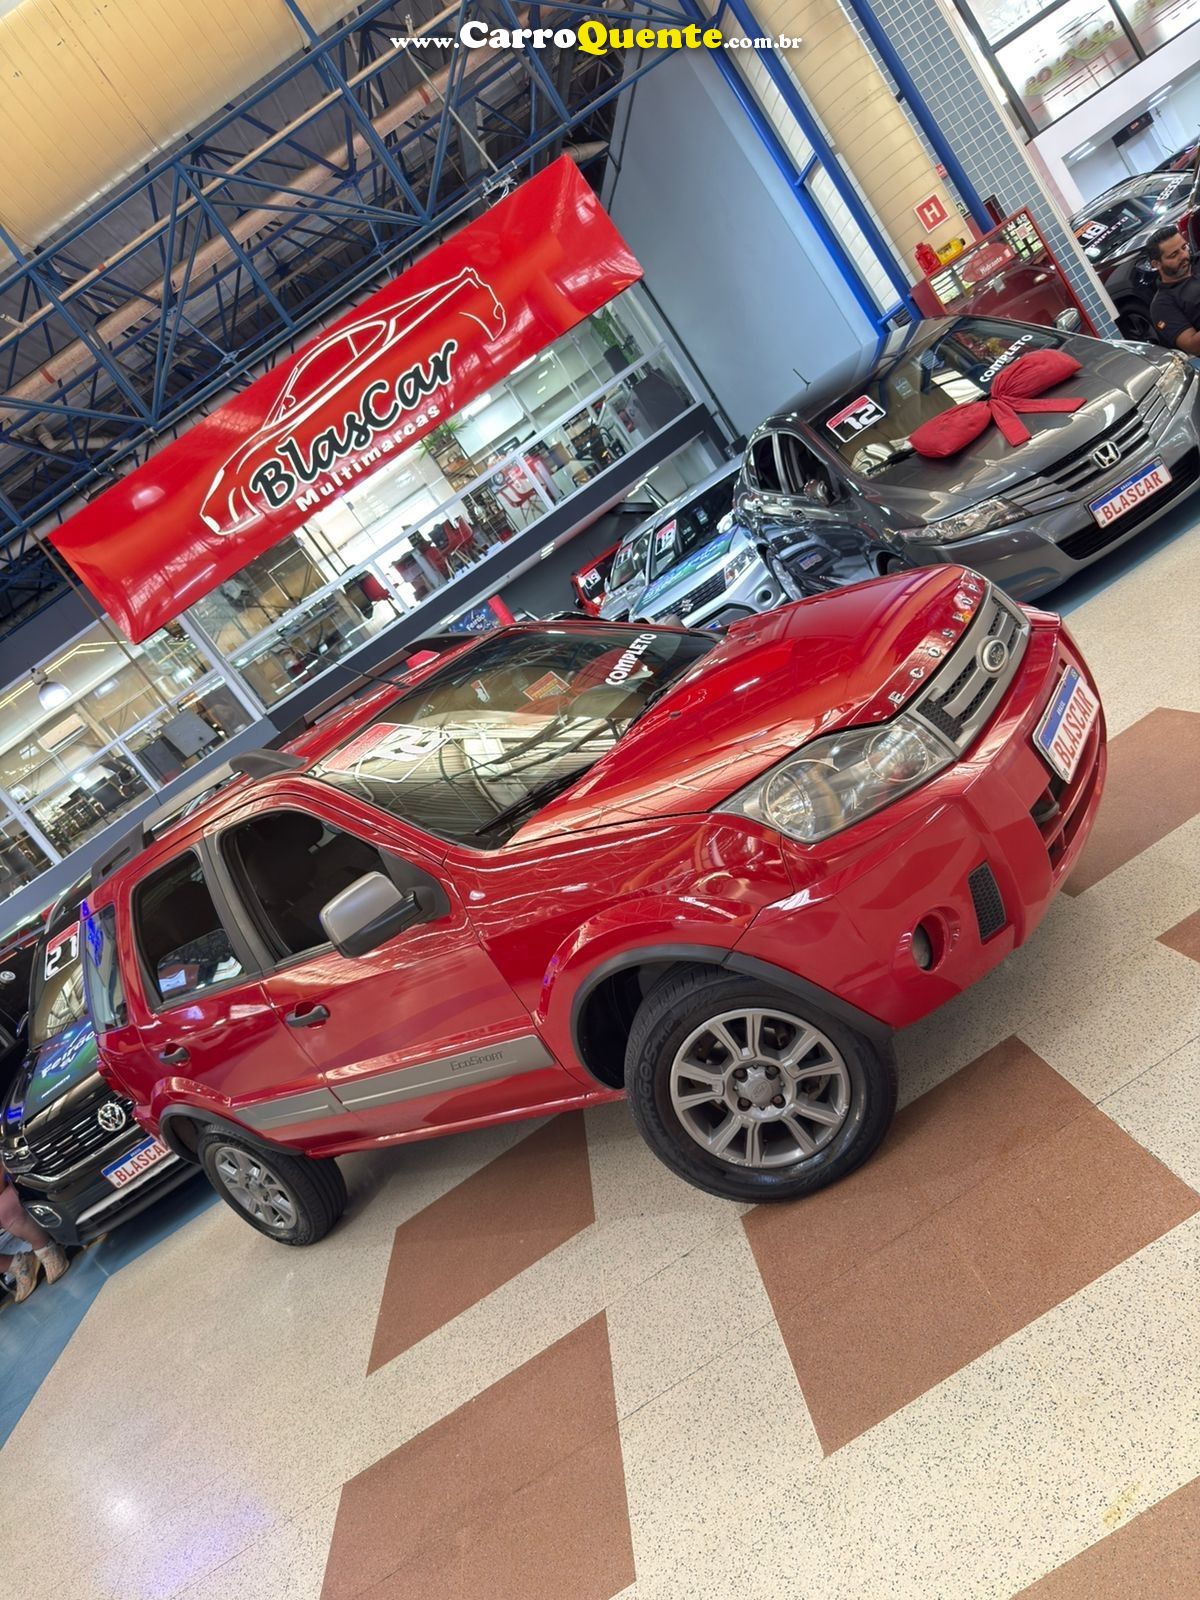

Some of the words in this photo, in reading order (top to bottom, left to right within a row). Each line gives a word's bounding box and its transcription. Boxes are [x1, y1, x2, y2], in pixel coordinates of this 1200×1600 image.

[979, 334, 1033, 383] COMPLETO
[249, 338, 459, 508] BlasCar
[844, 402, 878, 431] 12
[294, 404, 441, 512] Multimarcas
[1101, 470, 1164, 521] BLASCAR
[605, 633, 657, 686] COMPLETO
[1053, 686, 1094, 769] BLASCAR
[47, 935, 78, 977] 21
[113, 1144, 169, 1183] BLASCA
